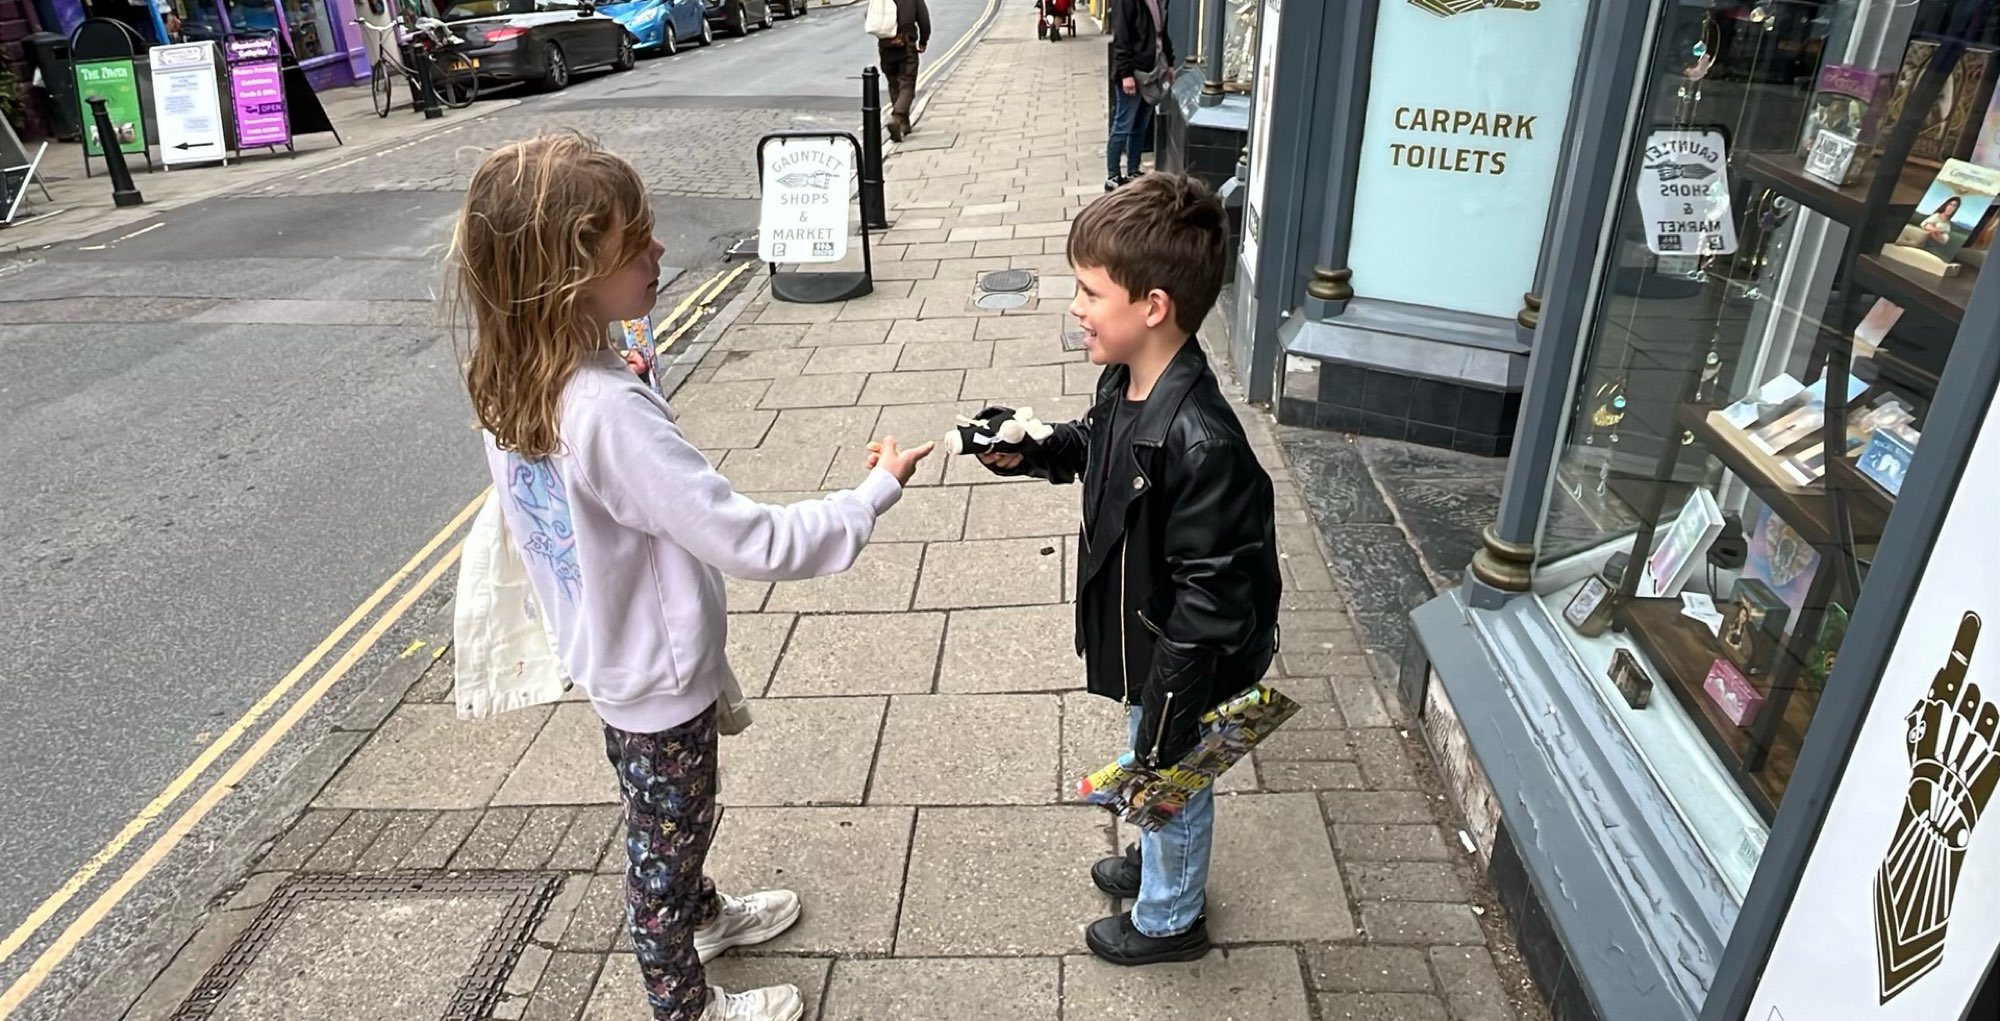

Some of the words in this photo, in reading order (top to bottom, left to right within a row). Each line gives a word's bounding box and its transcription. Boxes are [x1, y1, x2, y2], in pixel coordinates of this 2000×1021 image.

[1394, 107, 1538, 140] CARPARK
[772, 150, 844, 173] GAUNTLET
[1390, 143, 1507, 175] TOILETS
[780, 193, 829, 205] SHOPS
[799, 211, 808, 222] &
[772, 228, 834, 241] MARKET
